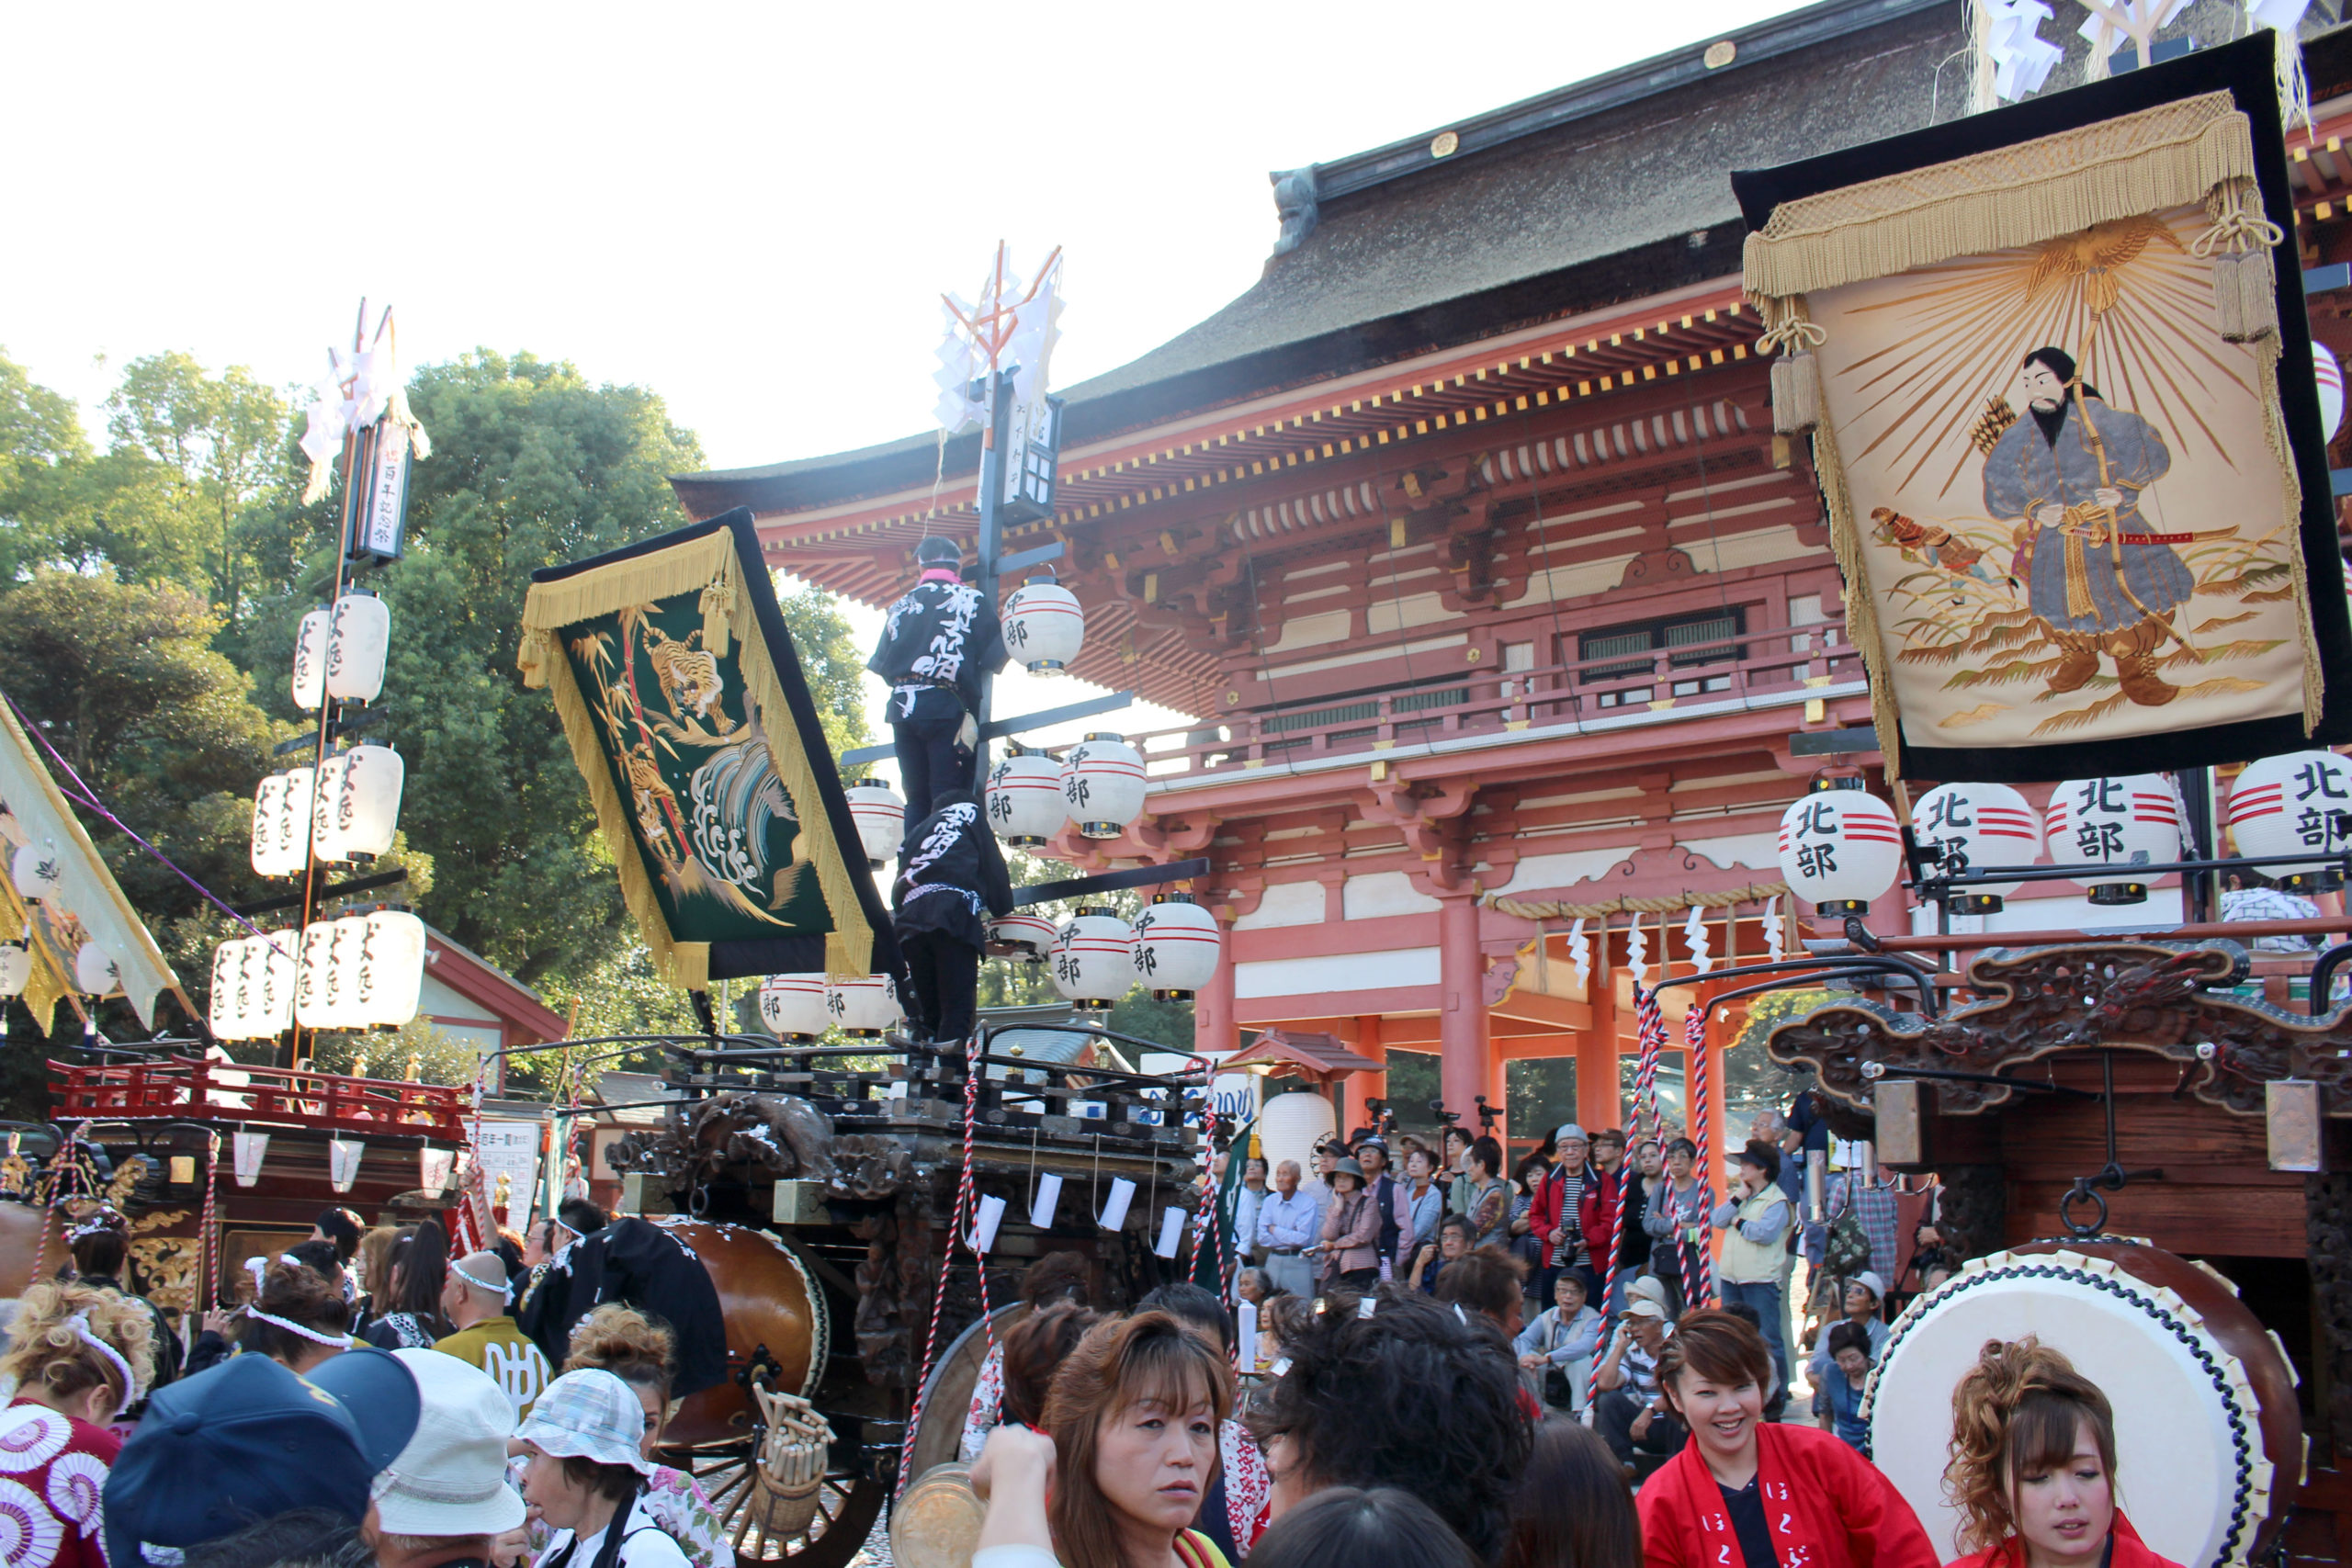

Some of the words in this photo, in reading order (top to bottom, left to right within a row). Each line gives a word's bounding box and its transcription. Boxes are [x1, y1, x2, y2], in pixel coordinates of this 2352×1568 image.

[1007, 592, 1028, 649] 中部
[990, 762, 1012, 823] 中部
[1066, 747, 1091, 808] 中部
[2293, 761, 2349, 854] 北部
[1796, 802, 1838, 880] 北部
[2076, 777, 2127, 863] 北部
[1057, 923, 1081, 987] 中部
[1134, 911, 1157, 976] 中部
